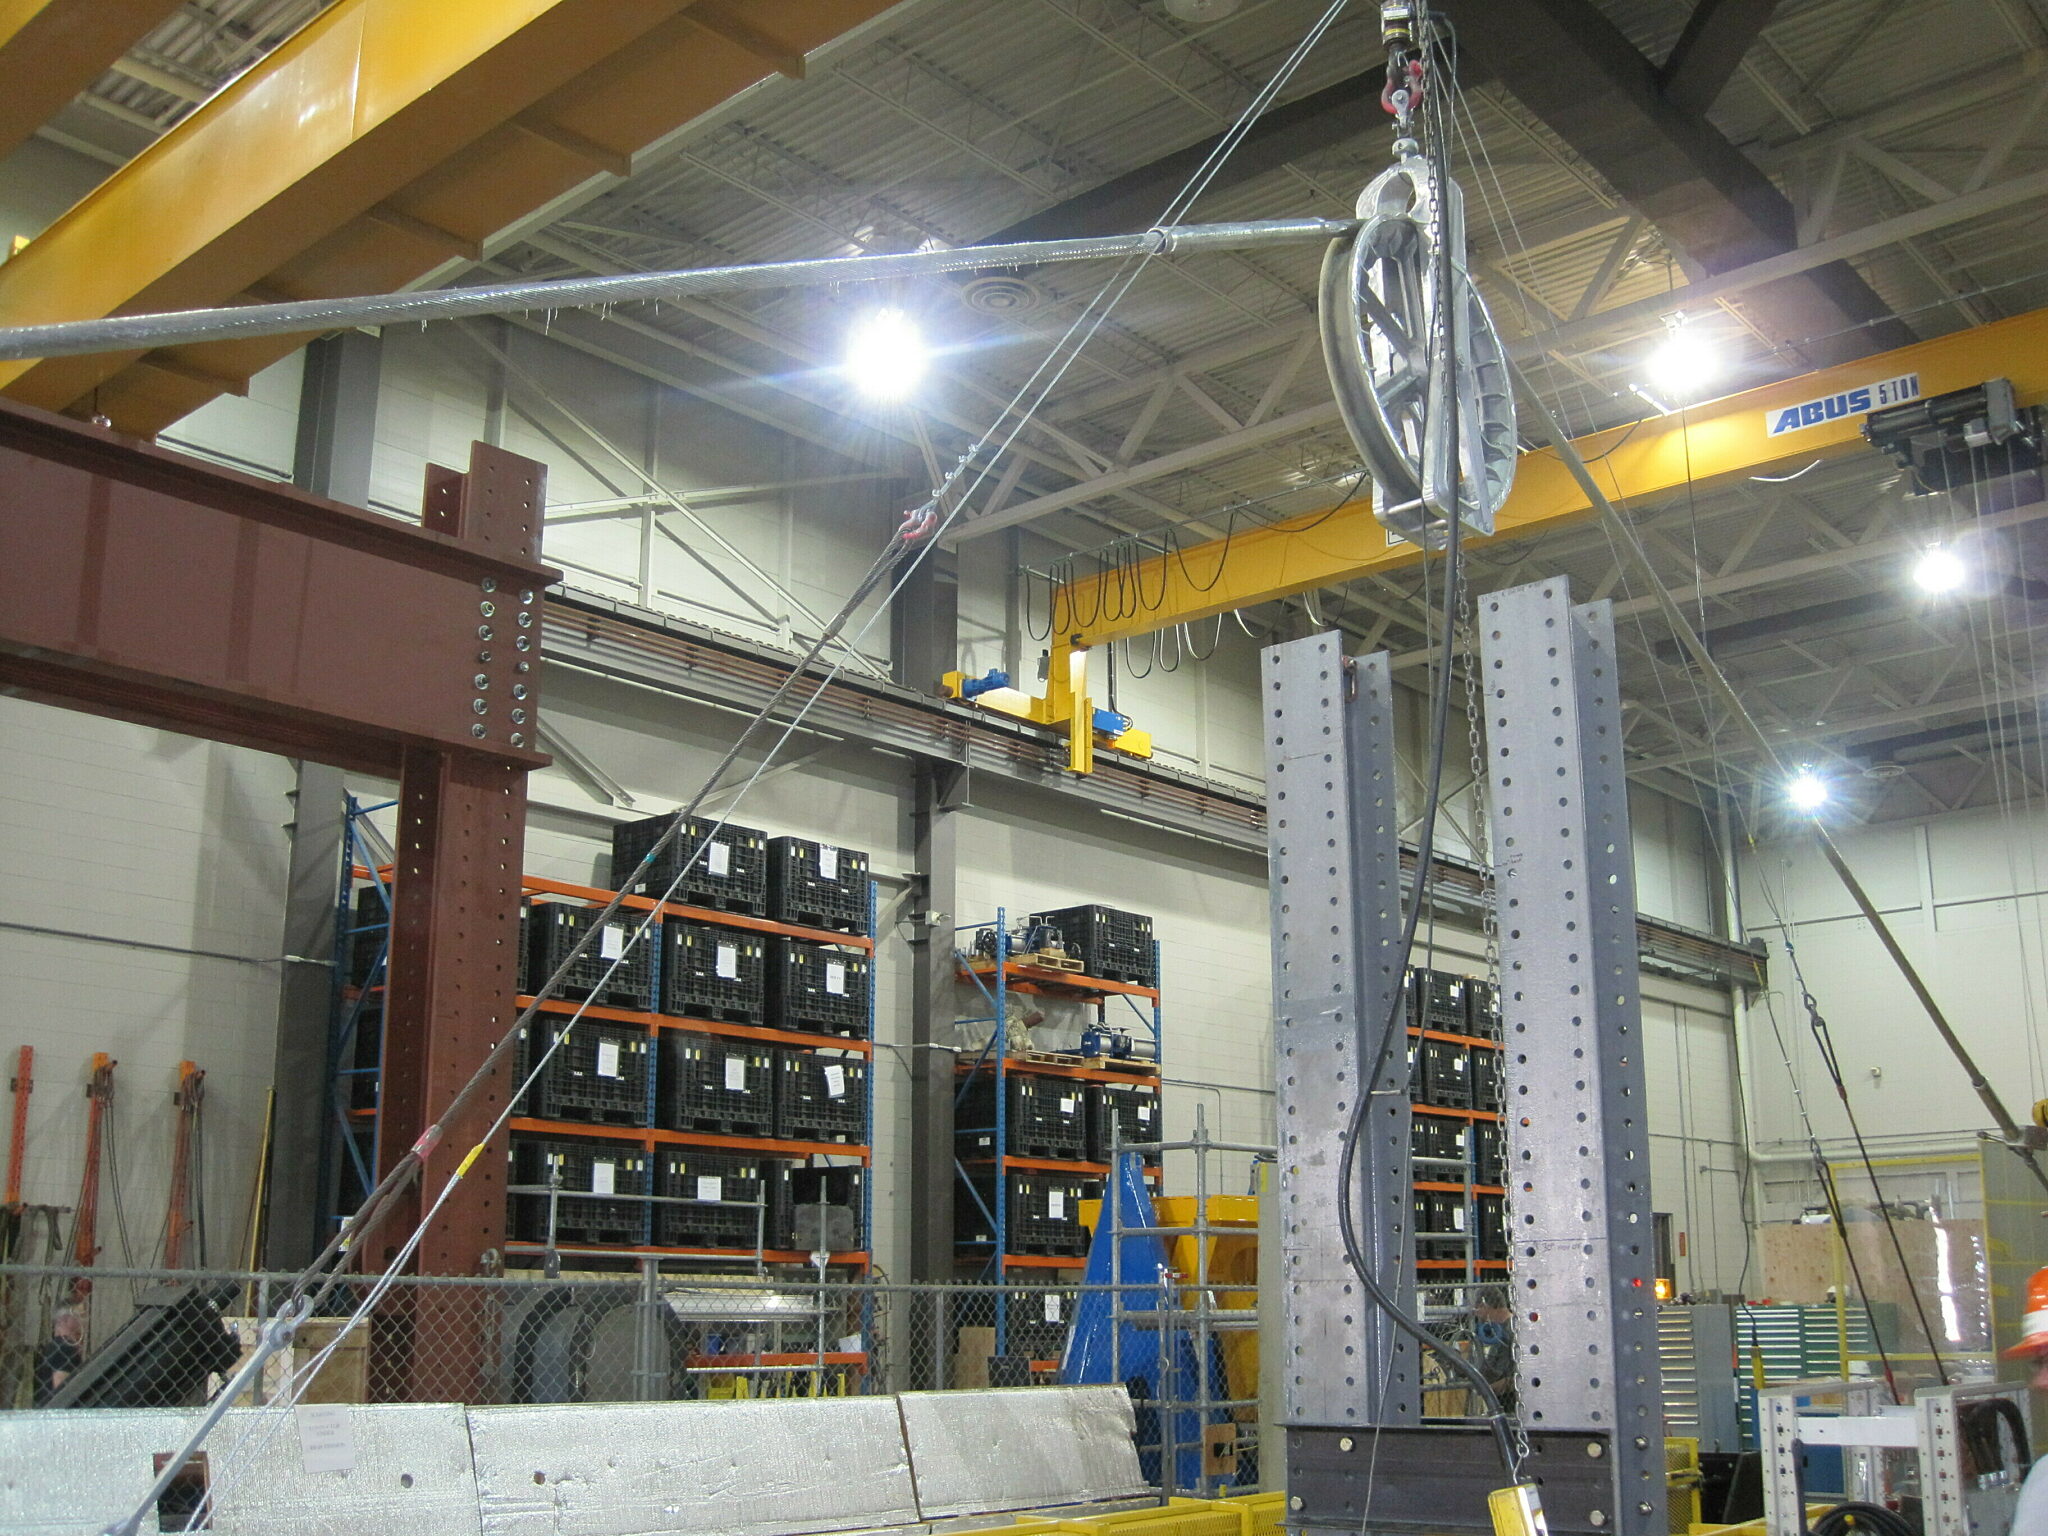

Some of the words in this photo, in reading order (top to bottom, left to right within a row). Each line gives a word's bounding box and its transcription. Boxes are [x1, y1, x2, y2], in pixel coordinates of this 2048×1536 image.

[1773, 388, 1872, 434] ABUS
[1878, 384, 1888, 405] 5
[1891, 375, 1920, 401] TON
